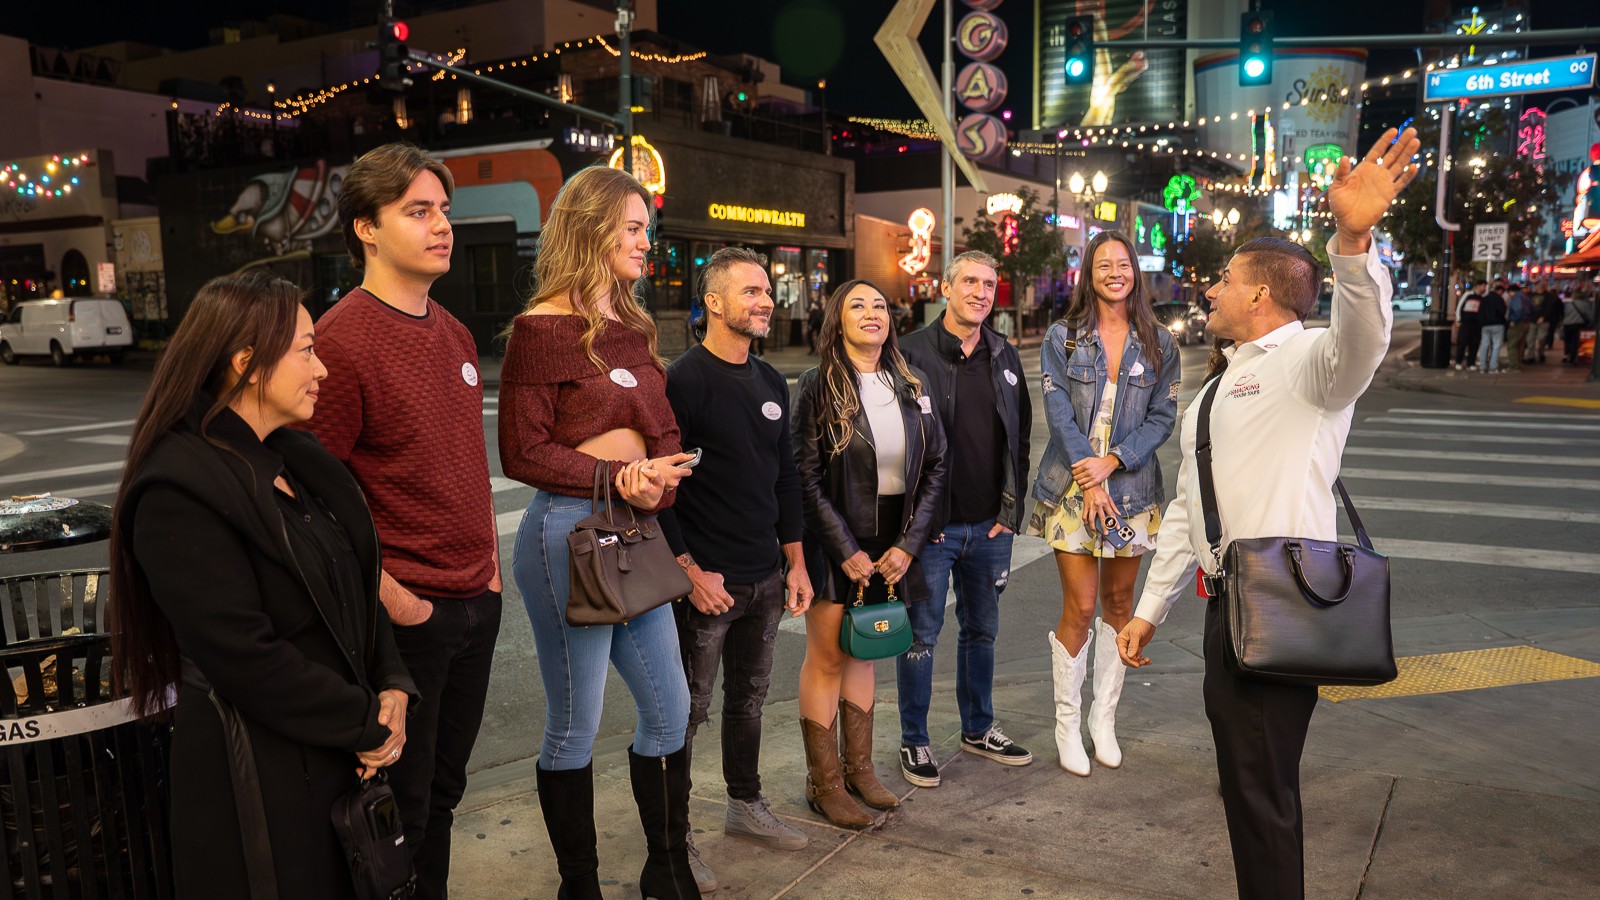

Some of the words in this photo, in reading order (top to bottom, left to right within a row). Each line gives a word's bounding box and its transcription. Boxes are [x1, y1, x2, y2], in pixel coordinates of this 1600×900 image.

[1431, 76, 1441, 87] N
[1465, 75, 1494, 91] 6th
[1499, 68, 1551, 88] Street
[708, 203, 806, 228] COMMONWEALTH
[1477, 243, 1503, 257] 25
